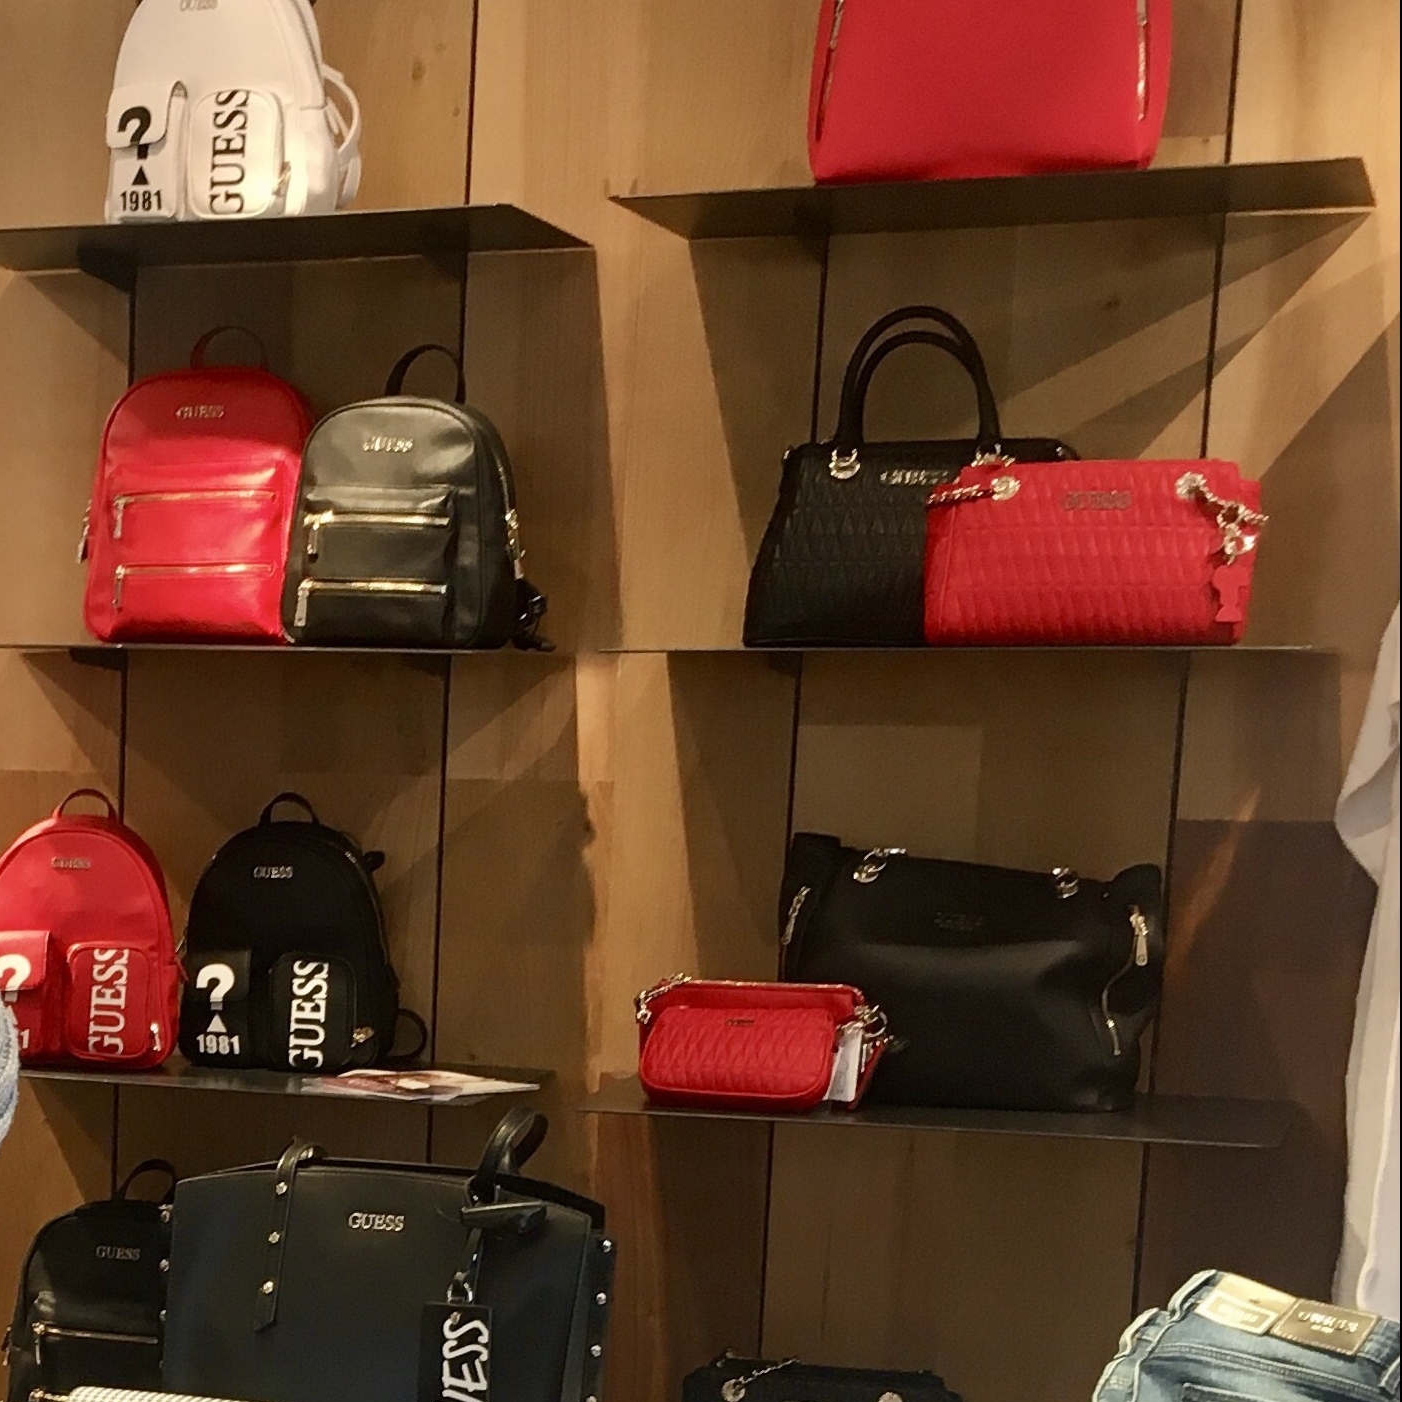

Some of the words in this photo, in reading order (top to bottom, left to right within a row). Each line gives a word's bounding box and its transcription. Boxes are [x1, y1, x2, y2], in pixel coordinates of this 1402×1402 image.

[209, 90, 250, 215] GUESS
[119, 190, 163, 212] 1981
[253, 865, 294, 879] GUESS
[88, 948, 129, 1056] GUESS
[288, 960, 330, 1068] GUESS
[196, 1034, 240, 1055] 1981
[348, 1212, 405, 1232] GUESS
[95, 1244, 141, 1262] GUESS
